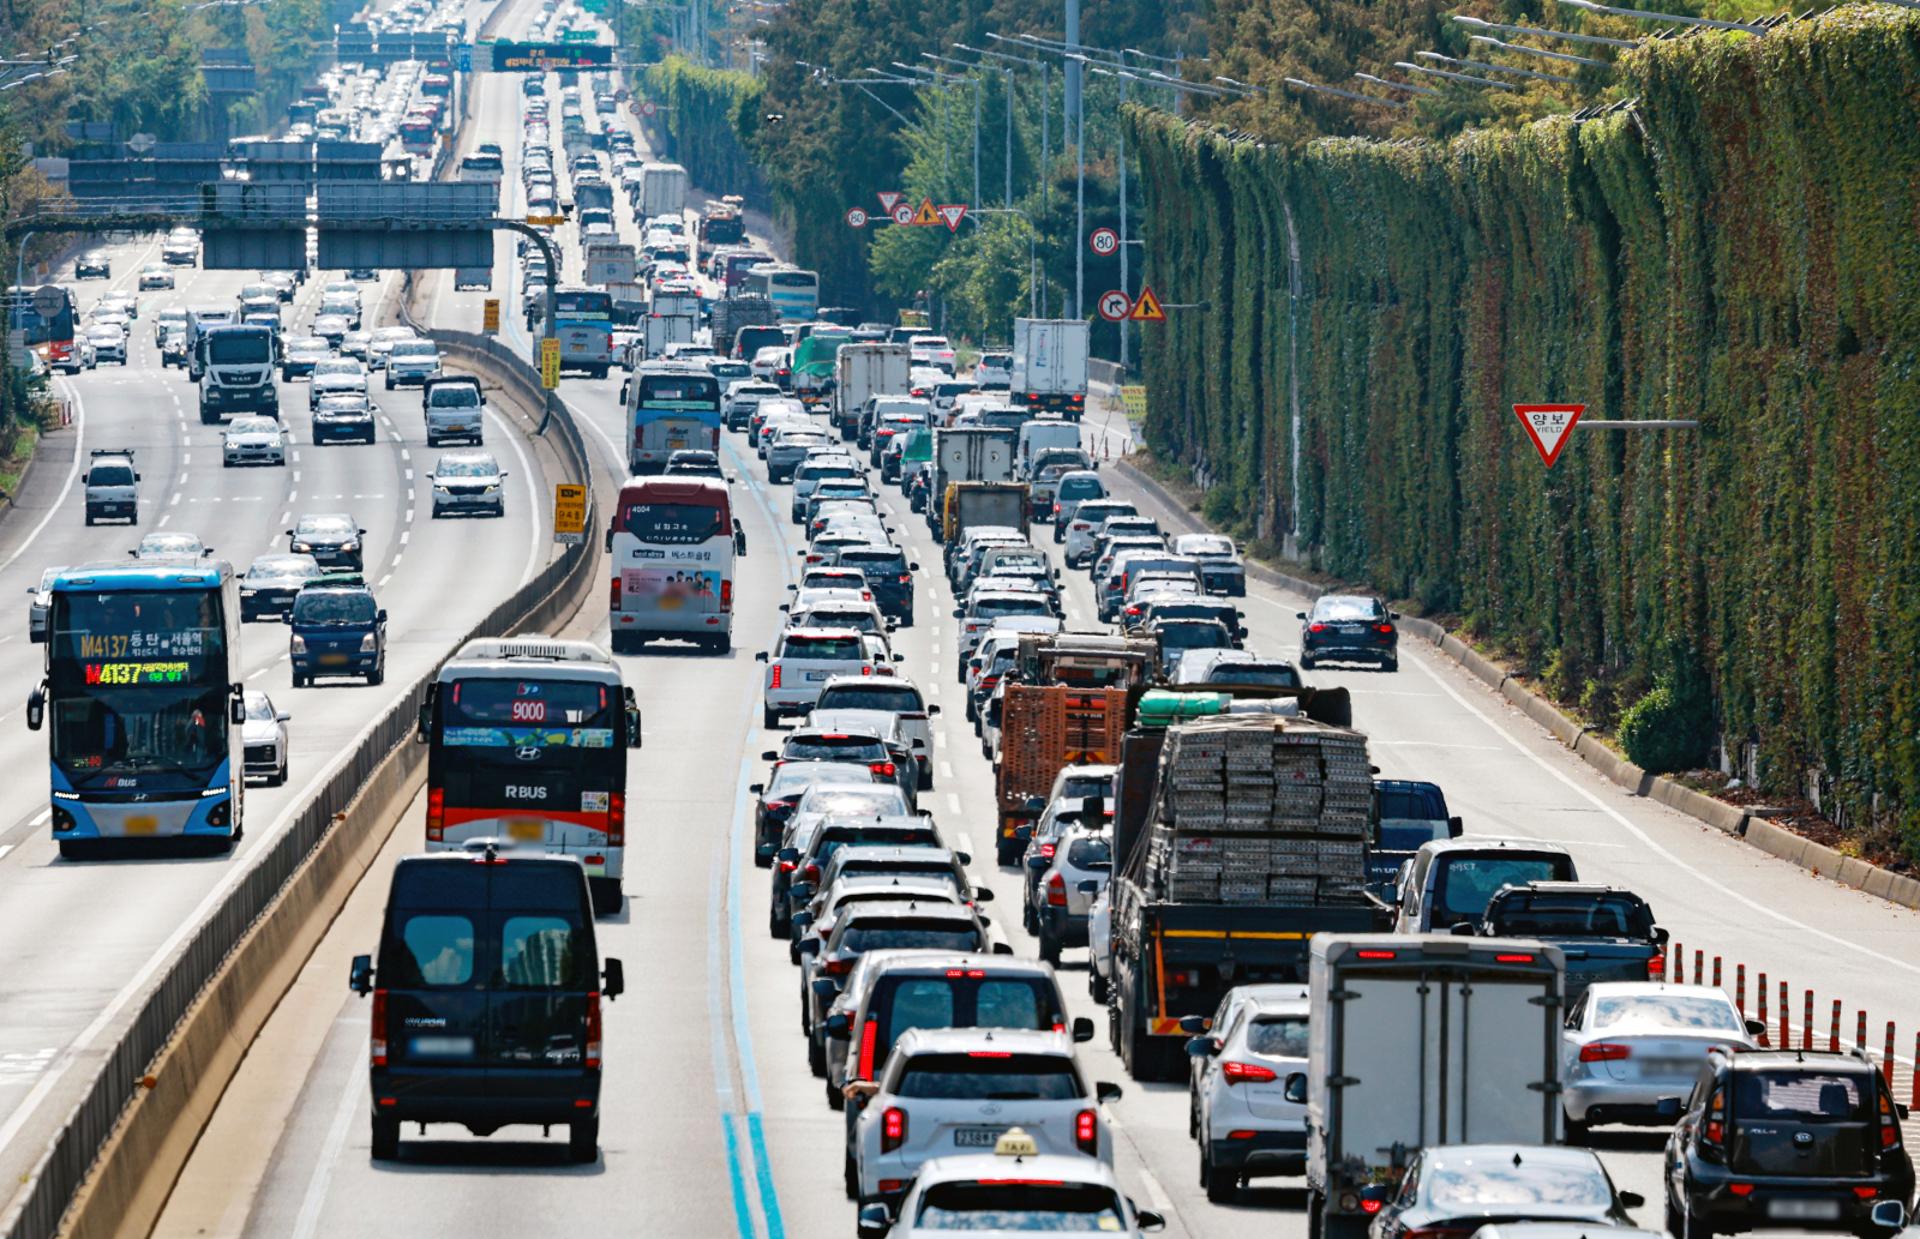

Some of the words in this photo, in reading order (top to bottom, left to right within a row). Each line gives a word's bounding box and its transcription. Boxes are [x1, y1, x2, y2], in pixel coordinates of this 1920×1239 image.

[1095, 234, 1114, 249] 80
[1533, 413, 1565, 426] 양보
[81, 634, 128, 658] M4137
[85, 662, 141, 684] M4137
[513, 702, 545, 720] 9000
[1004, 1142, 1032, 1152] TAXI
